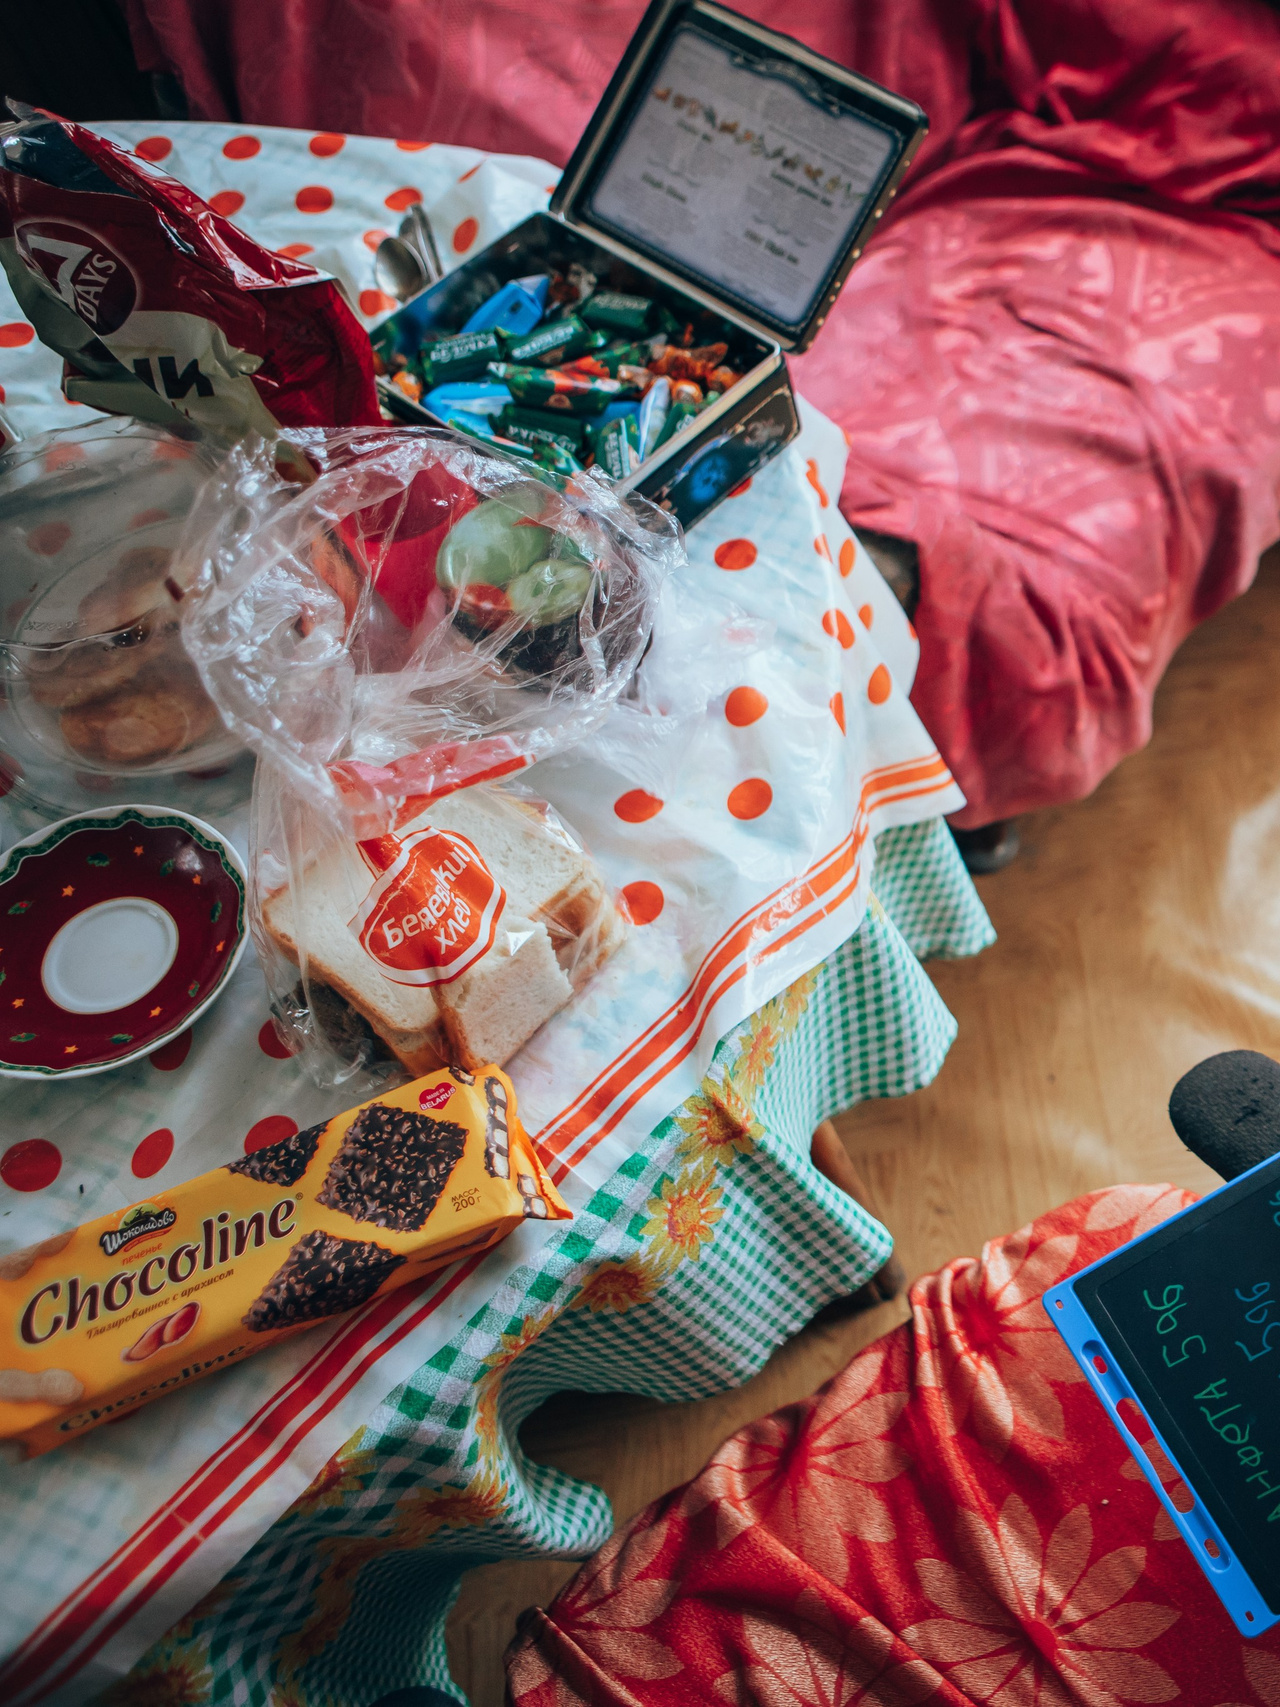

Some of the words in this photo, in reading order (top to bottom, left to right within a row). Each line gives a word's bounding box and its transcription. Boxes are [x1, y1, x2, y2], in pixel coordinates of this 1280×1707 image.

[26, 234, 93, 312] 7
[74, 253, 118, 324] DAYS
[419, 1086, 456, 1111] BELARUS
[451, 1187, 480, 1203] МАССА
[453, 1196, 475, 1213] 200
[103, 1210, 176, 1254] Шоколадово
[121, 1242, 163, 1266] печенье
[19, 1198, 297, 1346] Chocoline
[181, 1268, 235, 1299] арахисом
